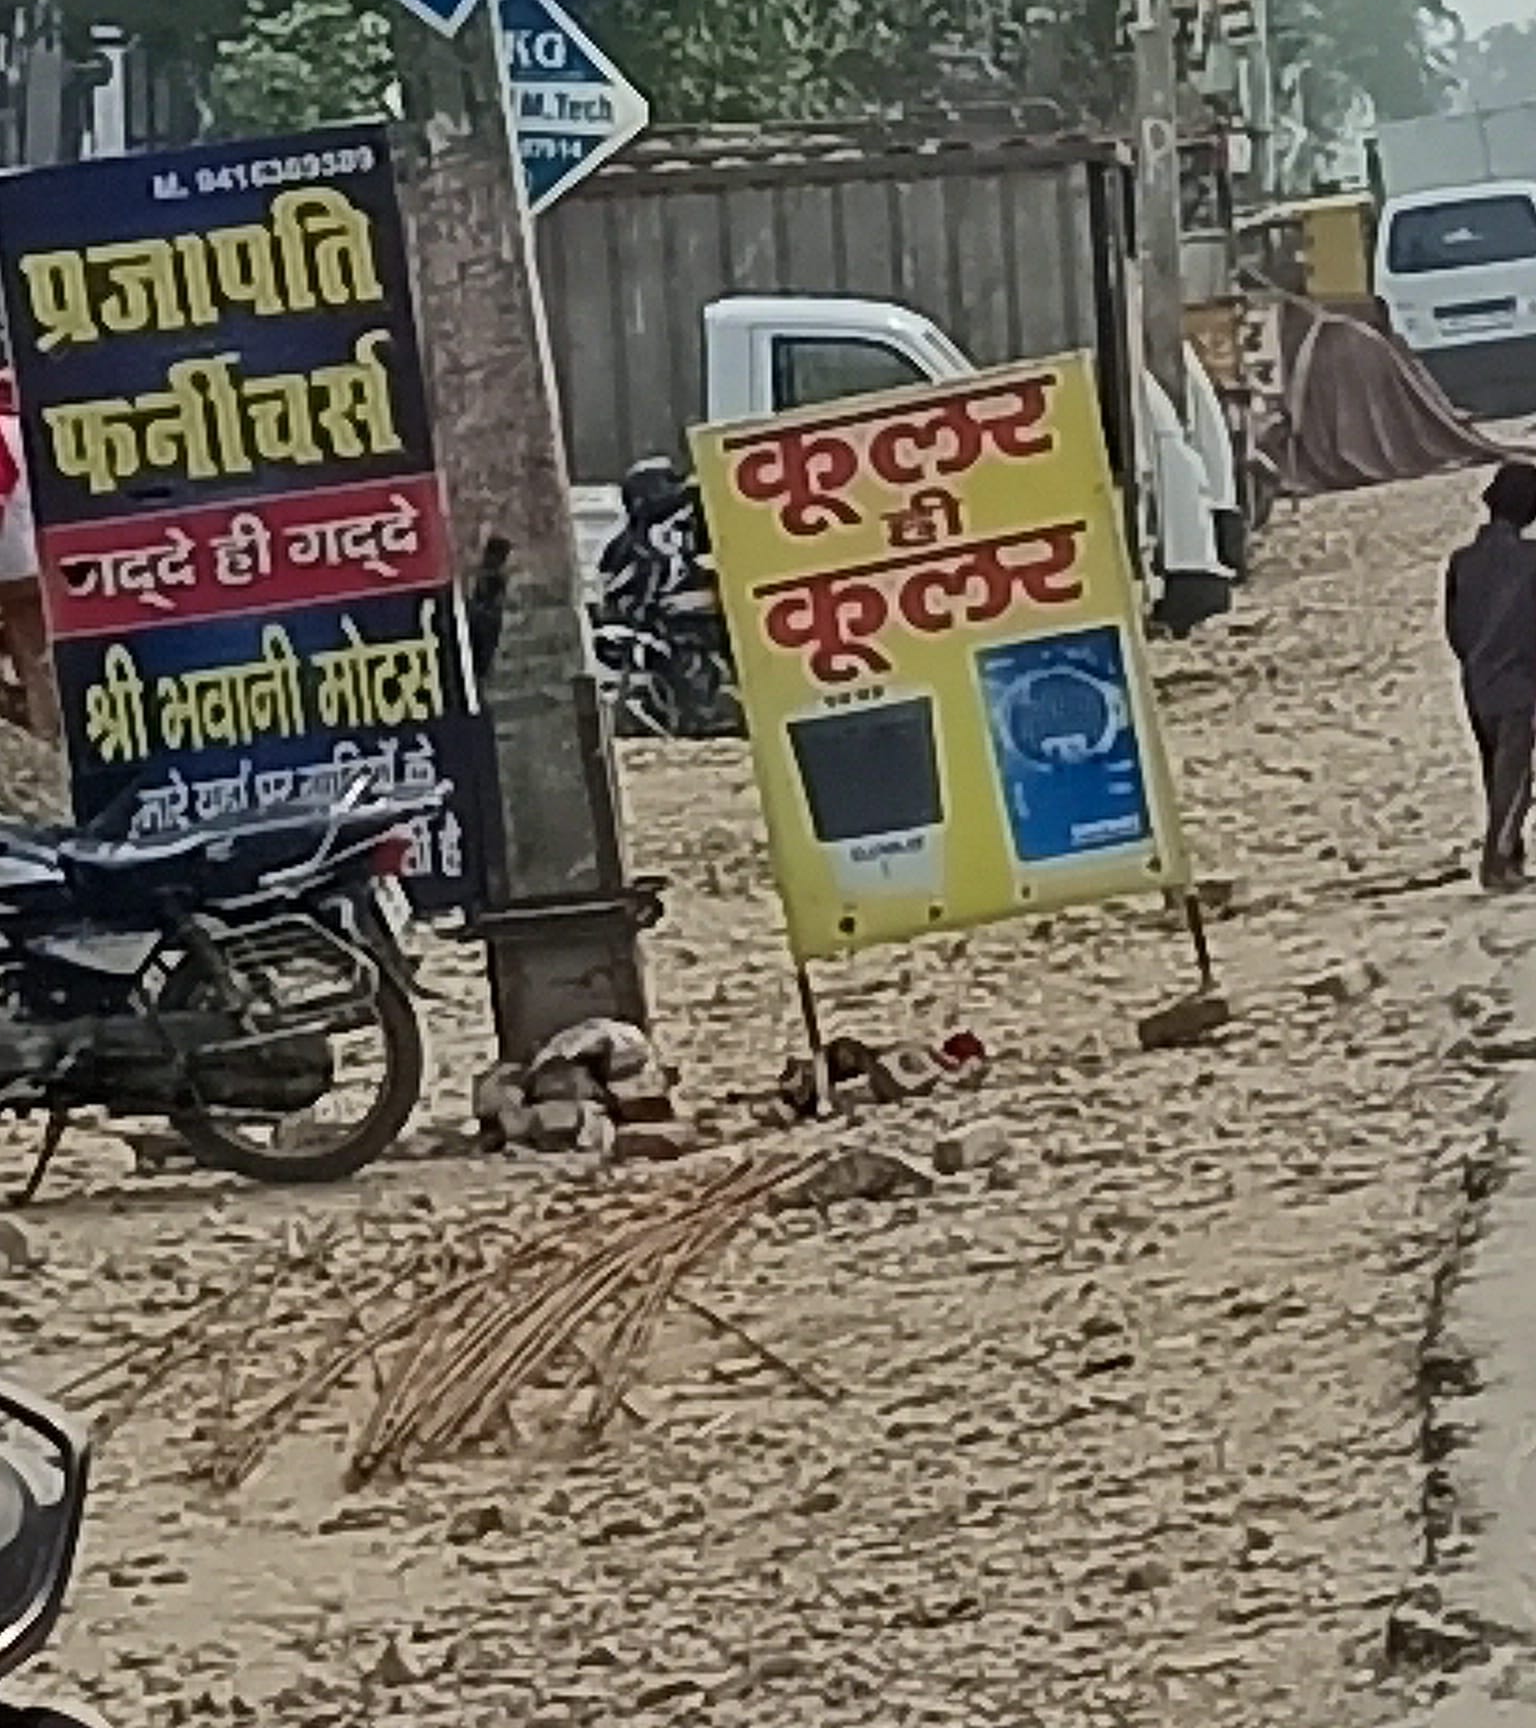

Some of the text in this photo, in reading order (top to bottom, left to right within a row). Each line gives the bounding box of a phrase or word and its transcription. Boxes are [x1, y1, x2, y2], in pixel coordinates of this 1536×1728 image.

[20, 185, 384, 353] प्रजापति
[722, 373, 1057, 537] कूलर
[880, 486, 963, 548] ही
[209, 512, 272, 586] ही
[753, 519, 1087, 684] कूलर
[84, 600, 445, 766] श्री भवानी मोटर्स
